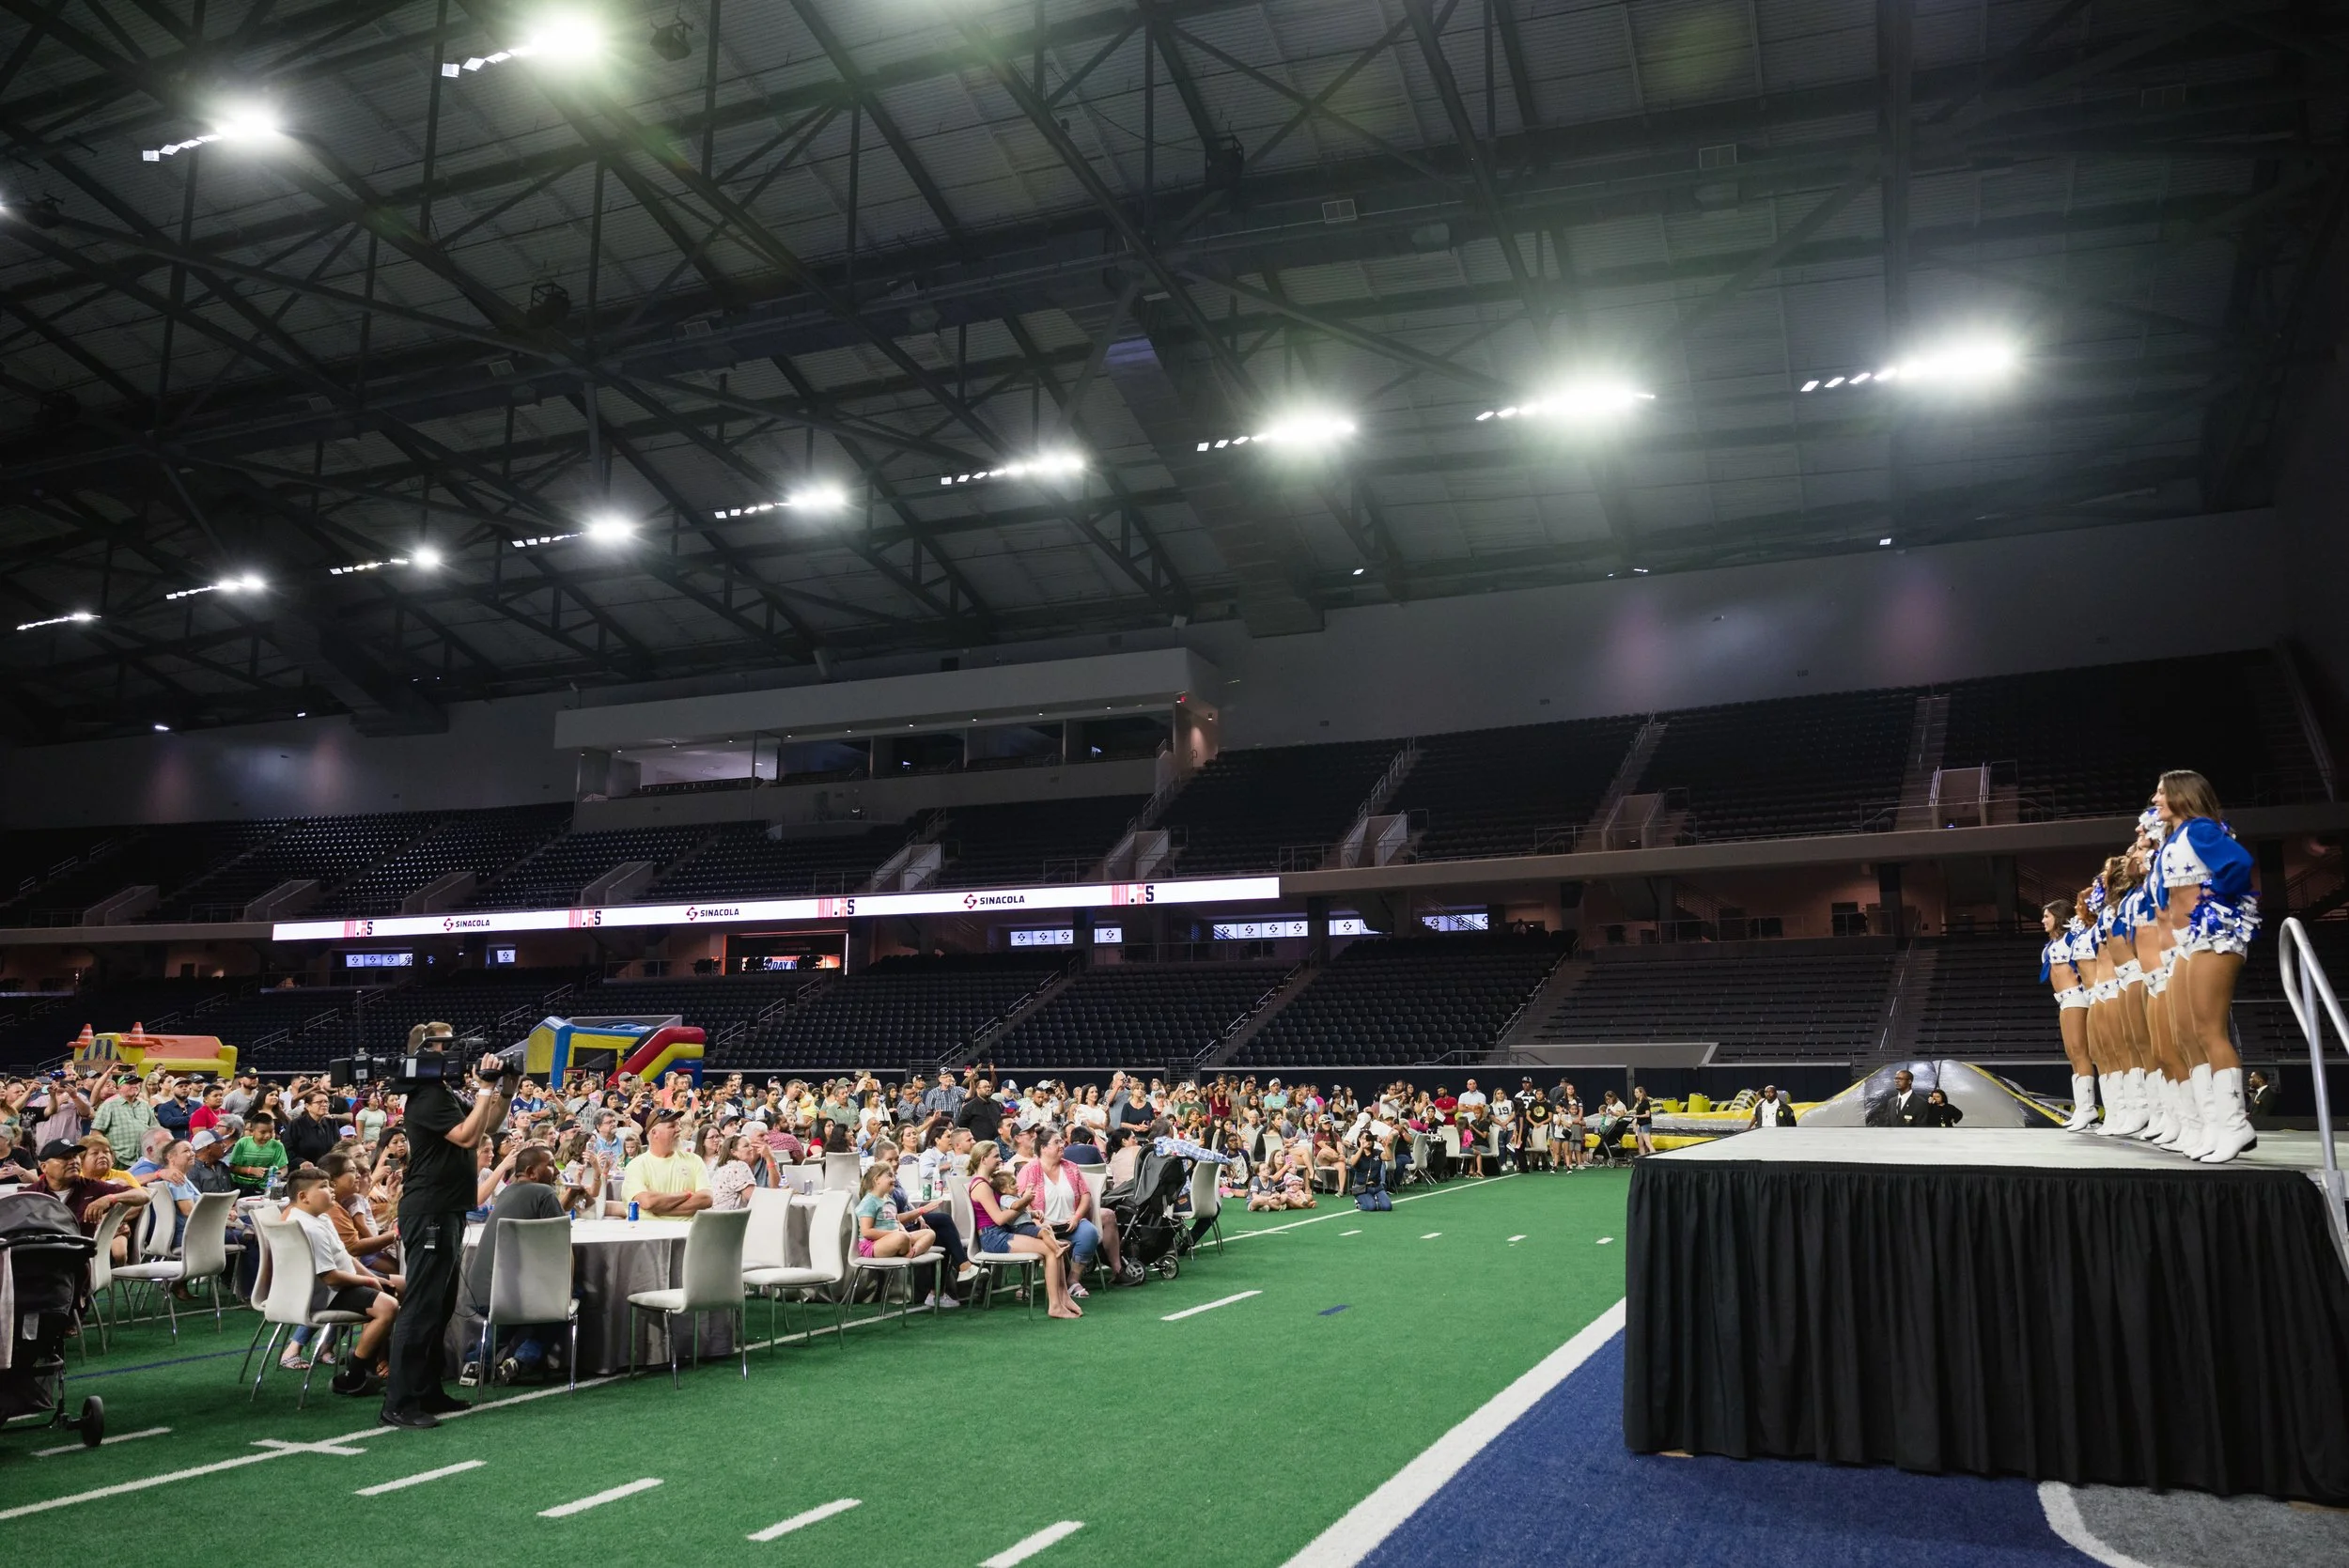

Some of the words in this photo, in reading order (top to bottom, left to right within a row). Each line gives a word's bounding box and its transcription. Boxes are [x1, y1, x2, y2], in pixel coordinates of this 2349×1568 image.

[979, 894, 1025, 906] SINACOLA
[700, 908, 739, 917] SINACOLA
[455, 919, 490, 928] SINACOLA
[1498, 1106, 1510, 1115] 19
